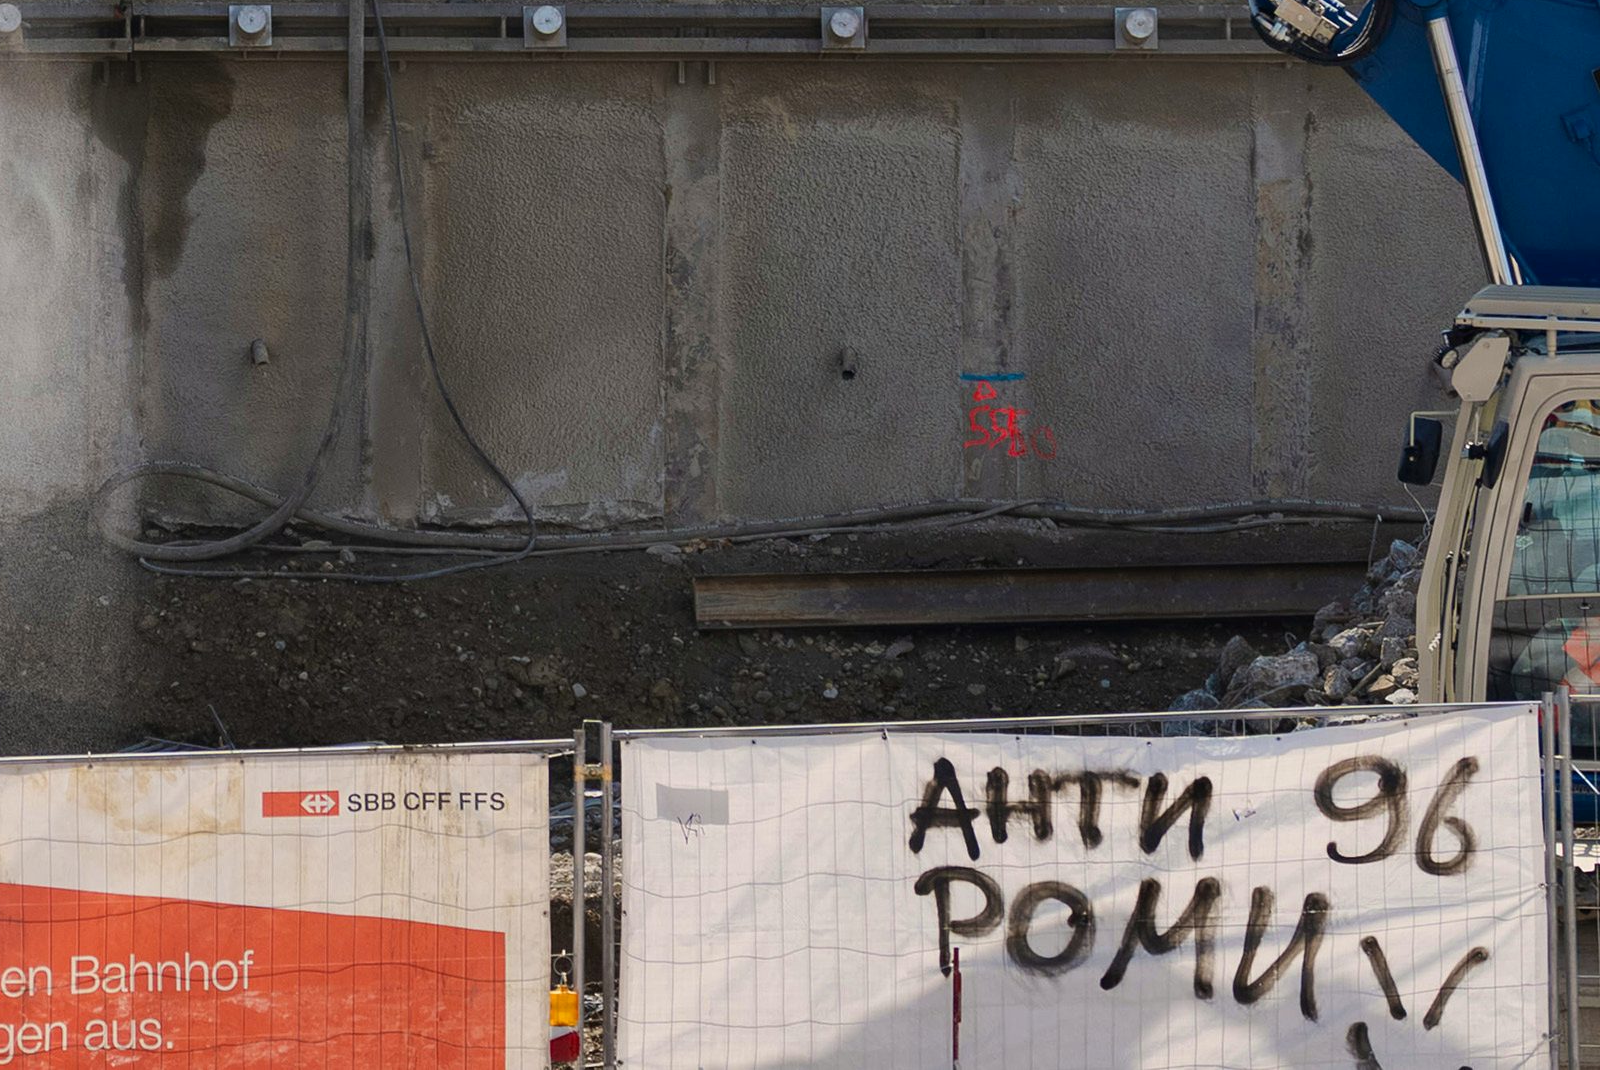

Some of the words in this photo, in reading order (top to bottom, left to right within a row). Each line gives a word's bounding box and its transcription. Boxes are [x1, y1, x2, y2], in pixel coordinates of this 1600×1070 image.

[347, 792, 396, 813] SBB
[403, 791, 451, 812] CFF
[459, 791, 506, 811] FFS
[909, 756, 1215, 861] АНТИ
[1313, 753, 1481, 878] 96
[912, 865, 1332, 1022] РОМИ
[70, 949, 254, 994] Bahnhof
[84, 1017, 175, 1052] aus.
